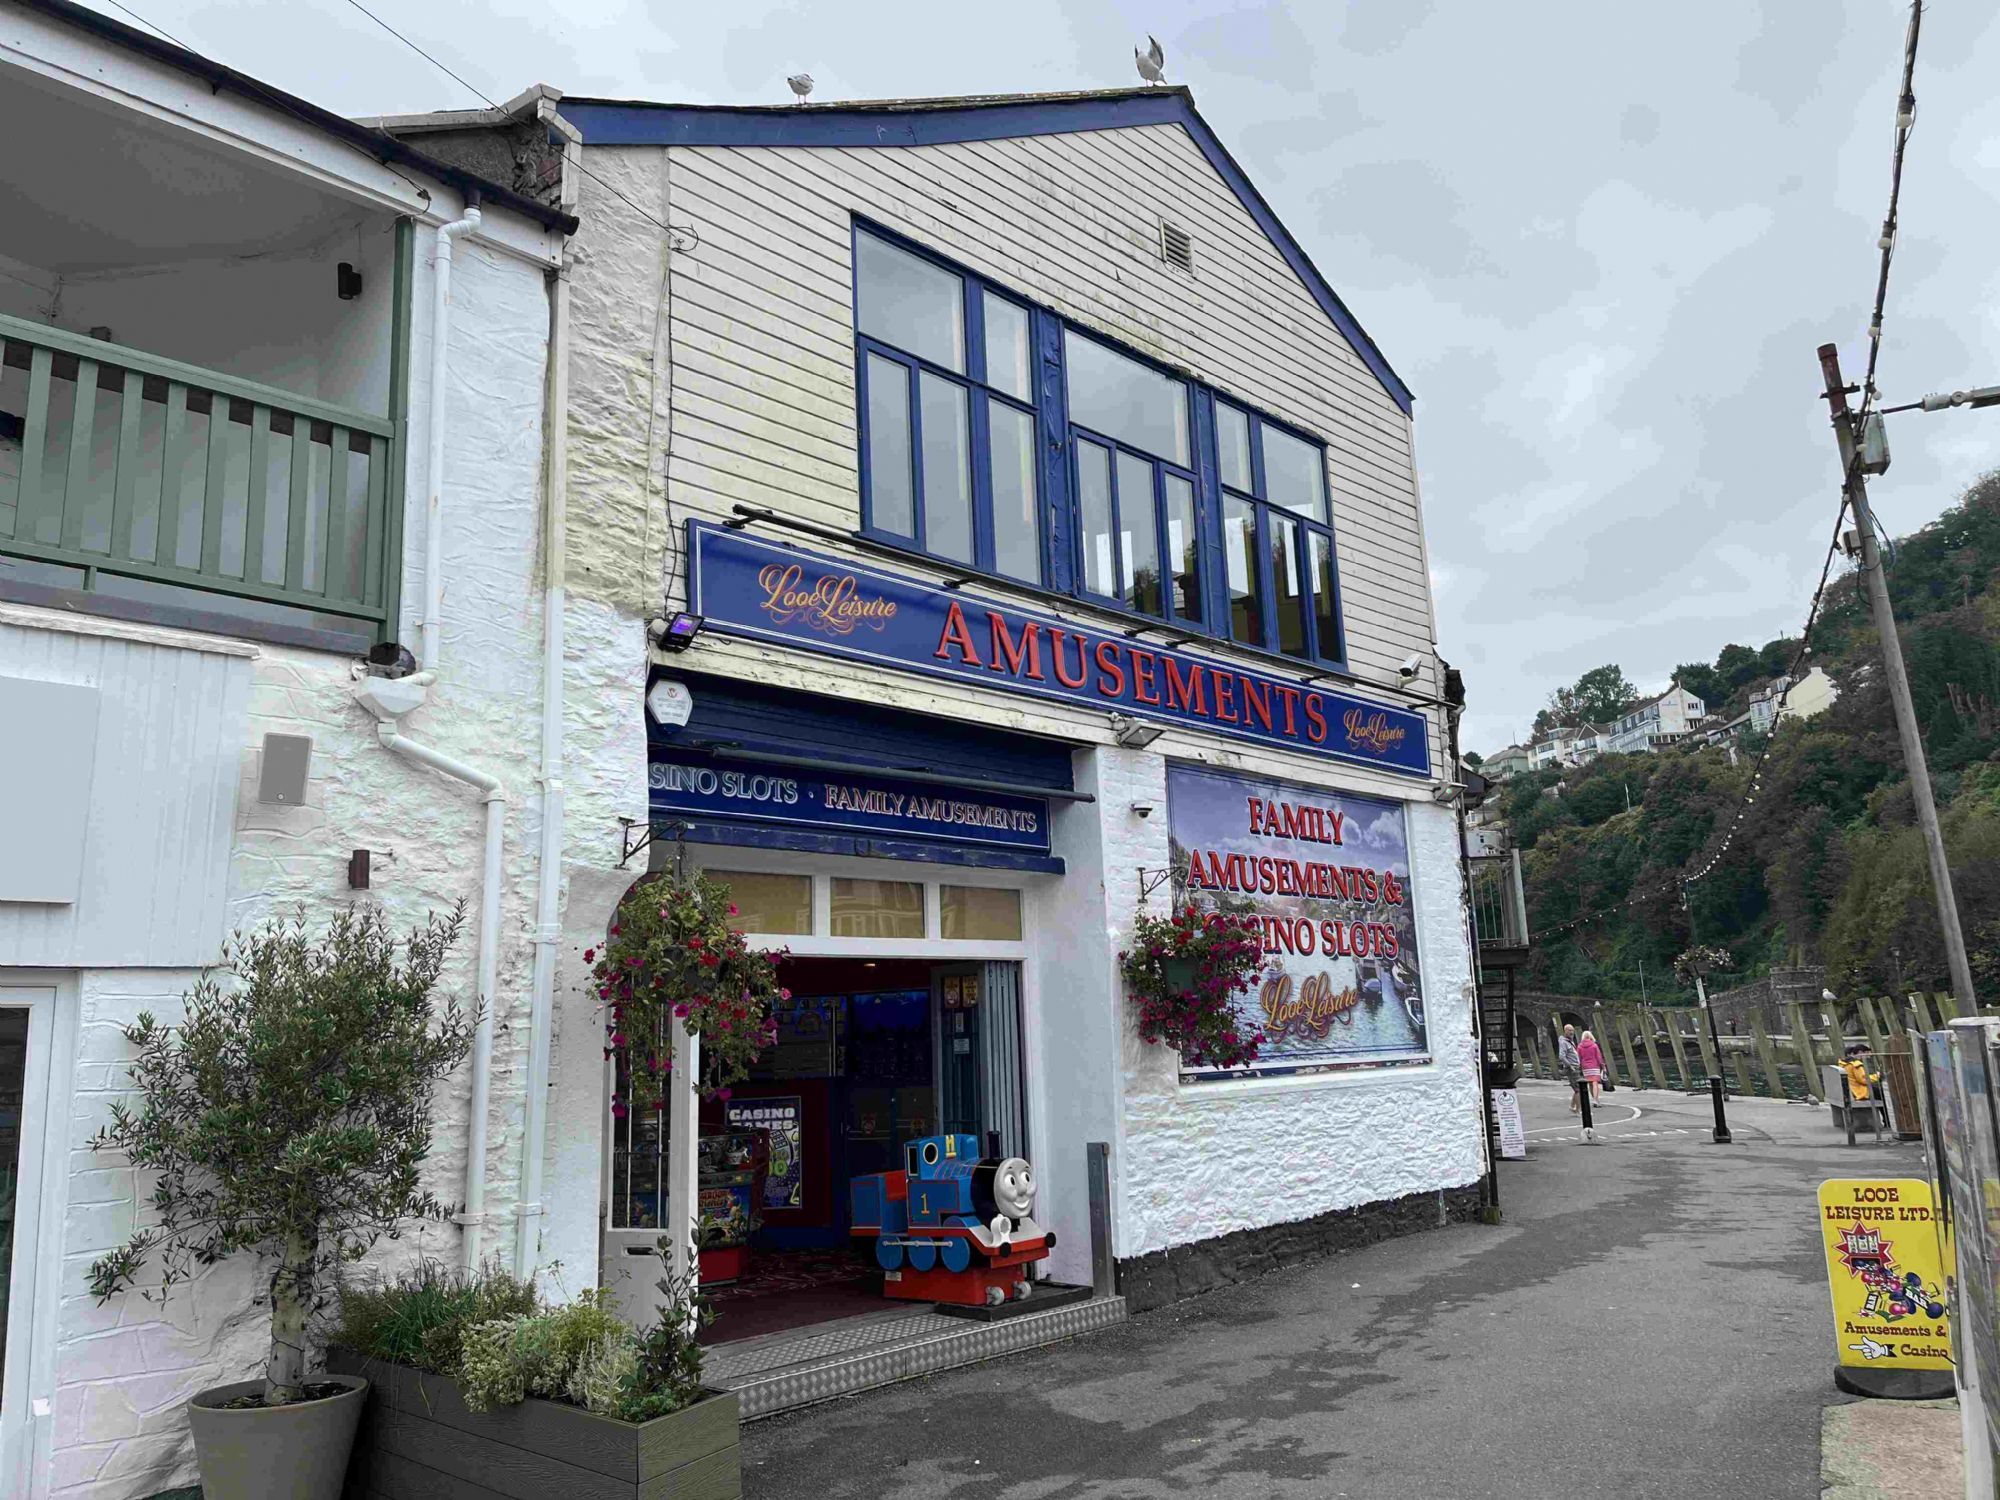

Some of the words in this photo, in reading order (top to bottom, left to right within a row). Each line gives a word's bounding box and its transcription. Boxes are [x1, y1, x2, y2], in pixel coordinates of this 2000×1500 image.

[759, 564, 820, 614] Looe
[816, 575, 898, 625] Leisure
[933, 602, 1328, 743] AMUSEMENTS
[1344, 709, 1371, 743] Looe
[1367, 713, 1405, 746] Leisure
[648, 762, 718, 795] SINO
[722, 771, 798, 804] SLOTS
[825, 784, 902, 816] FAMILY
[906, 797, 1037, 833] AMUSEMENTS
[1247, 797, 1344, 846] FAMILY
[1187, 849, 1379, 904] AMUSEMENTS
[1383, 870, 1404, 906] &
[1201, 911, 1316, 957] SINO
[1320, 919, 1400, 959] SLOTS
[1261, 974, 1305, 1032] Looe
[1301, 972, 1359, 1032] Leisure
[729, 1108, 795, 1120] CASINO
[731, 1120, 793, 1130] MES
[921, 1193, 930, 1215] 1
[1853, 1188, 1899, 1202] LOOE
[1825, 1206, 1895, 1220] LEISURE
[1898, 1207, 1934, 1221] LTD.
[1904, 1288, 1928, 1309] BAR
[1844, 1322, 1931, 1336] Amusements
[1935, 1325, 1947, 1337] &
[1901, 1344, 1948, 1358] Casino
